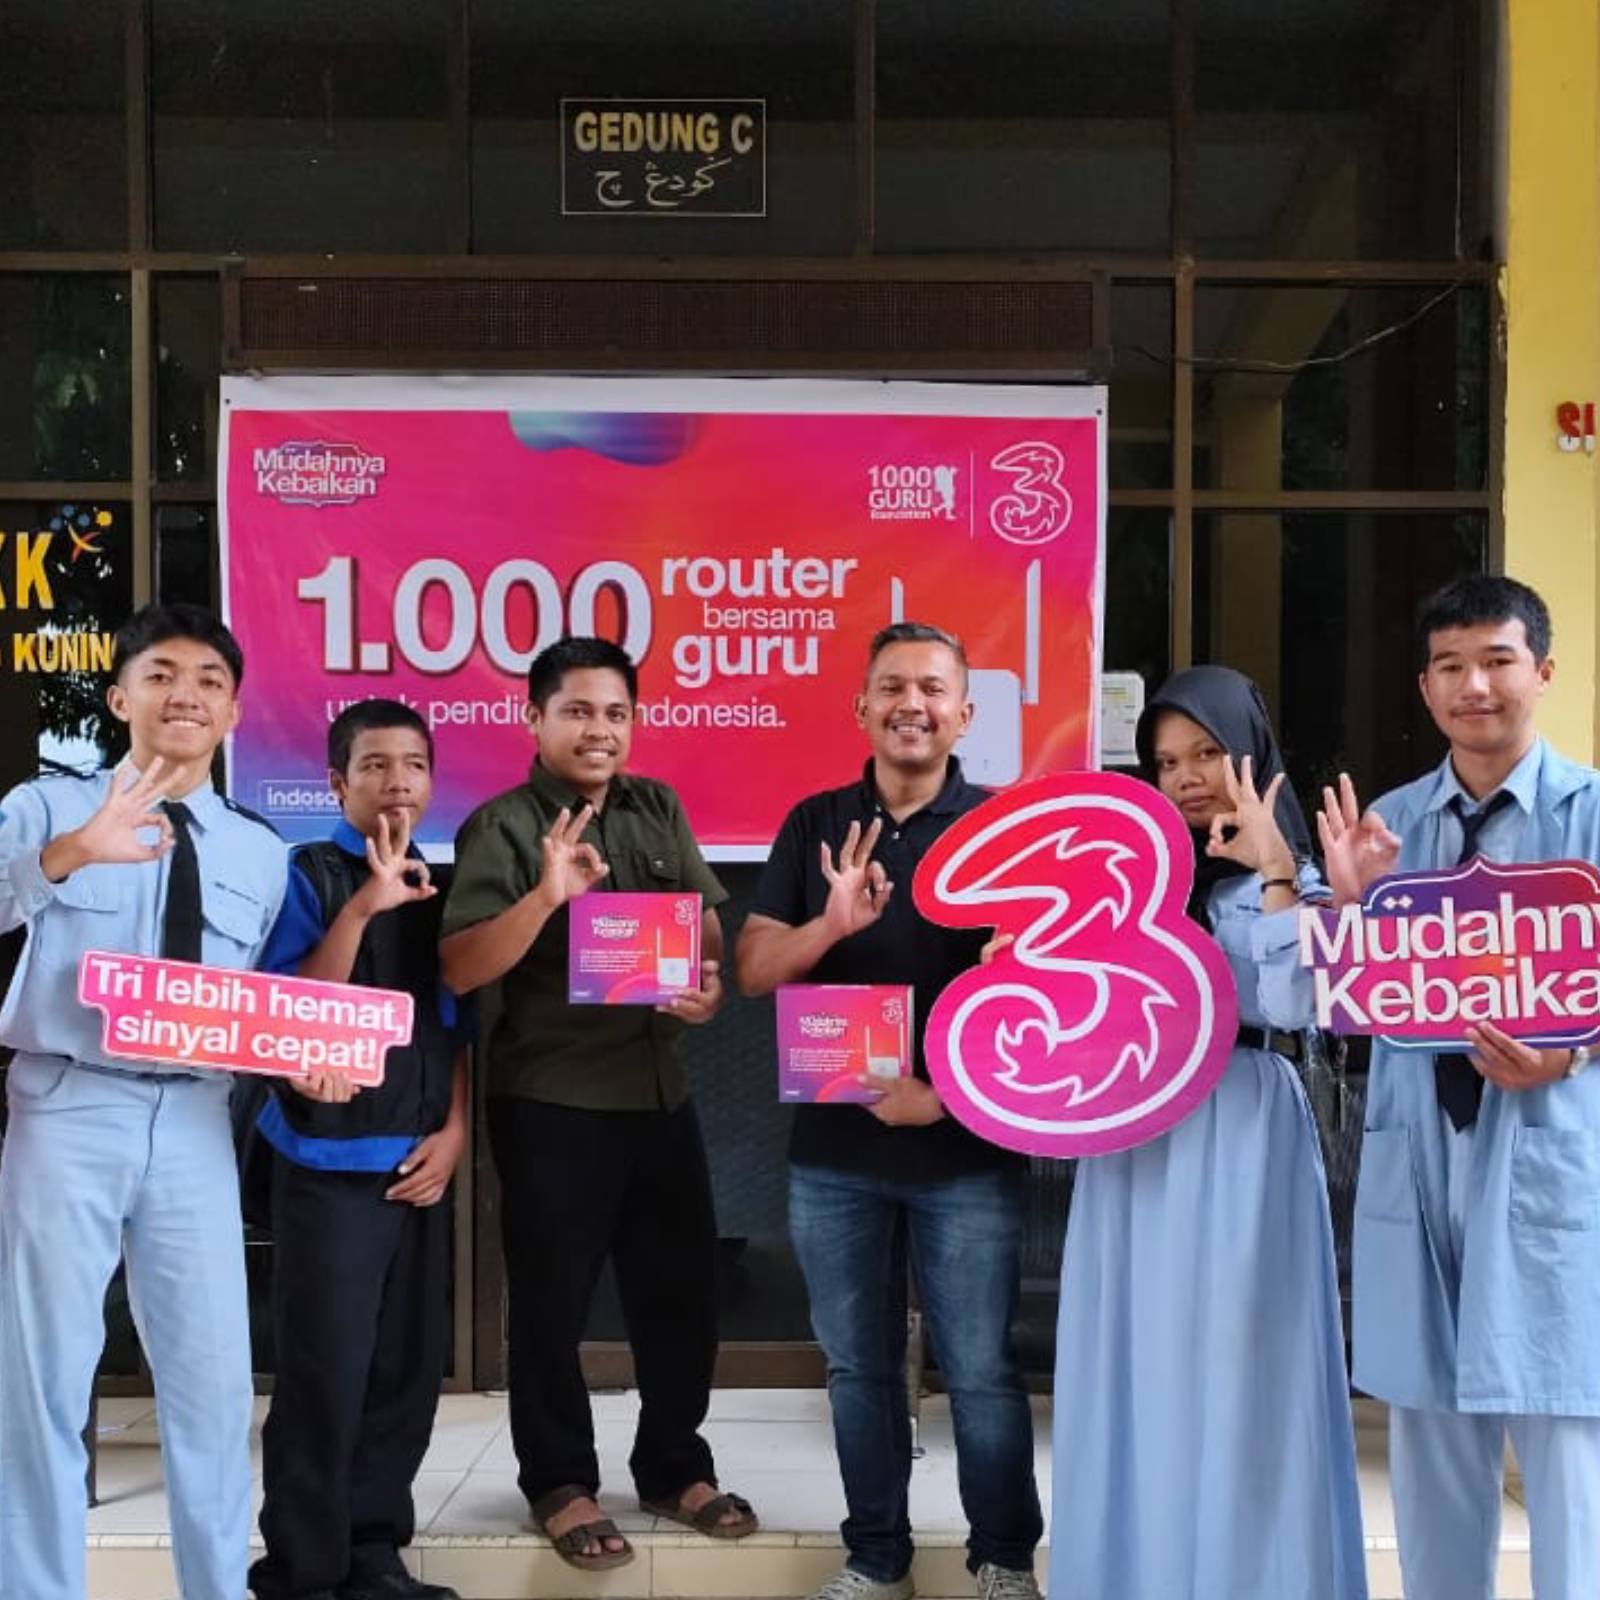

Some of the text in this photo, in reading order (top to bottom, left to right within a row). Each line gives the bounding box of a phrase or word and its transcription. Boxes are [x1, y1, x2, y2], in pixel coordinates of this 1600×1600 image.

[574, 112, 754, 154] GEDUNG C
[253, 447, 385, 477] Müdahnya
[256, 471, 377, 494] Kebaikan
[868, 465, 932, 488] 1000
[869, 489, 932, 509] GURU
[0, 531, 54, 609] K
[661, 548, 858, 598] router
[298, 556, 652, 673] 1.000
[704, 600, 835, 630] bersama
[14, 632, 117, 673] KUNIN
[673, 634, 819, 688] guru
[636, 697, 787, 728] ndonesia.
[267, 786, 339, 807] indosa
[1299, 892, 1600, 967] Müdahn
[91, 960, 405, 1038] Tri lebih hemat,
[115, 1010, 377, 1071] sinyal cepat!
